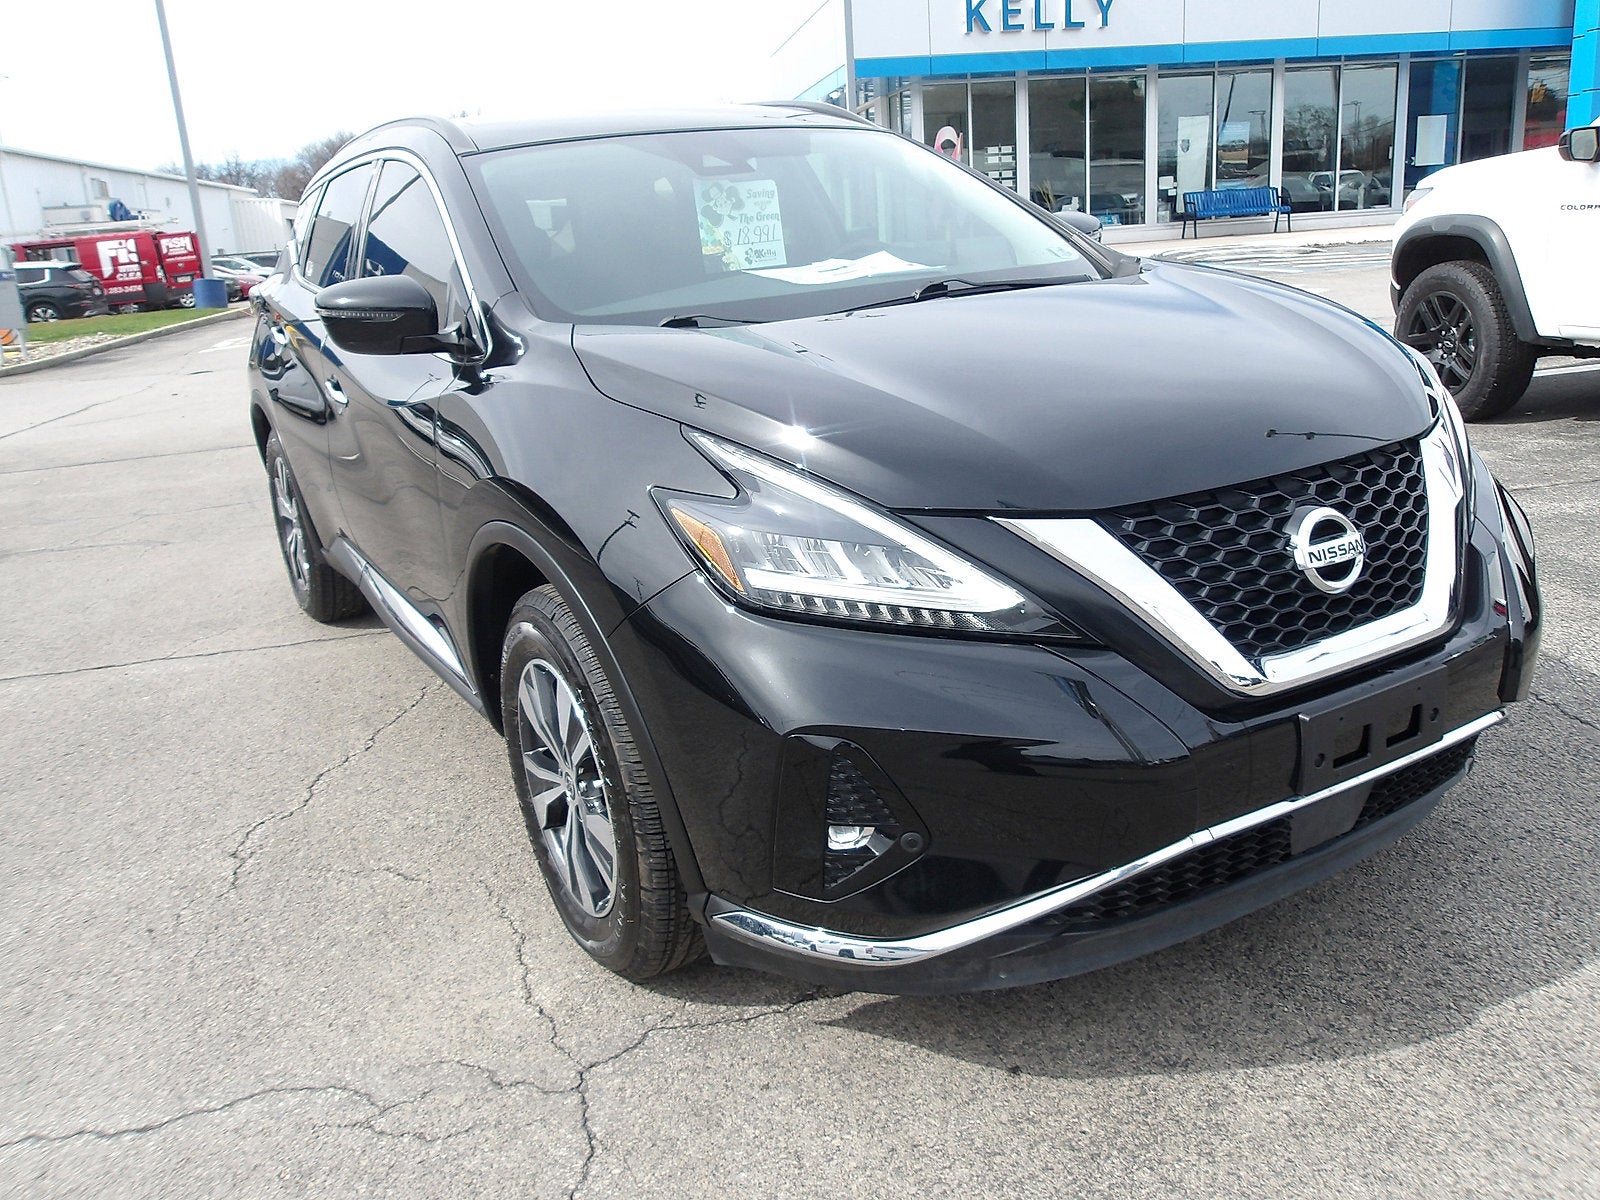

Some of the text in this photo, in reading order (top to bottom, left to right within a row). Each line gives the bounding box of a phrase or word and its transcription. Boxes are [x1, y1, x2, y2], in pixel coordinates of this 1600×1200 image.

[965, 0, 1114, 33] KELLY
[746, 189, 775, 199] Saving
[739, 211, 780, 224] The Green
[1308, 534, 1364, 563] NISSAN
